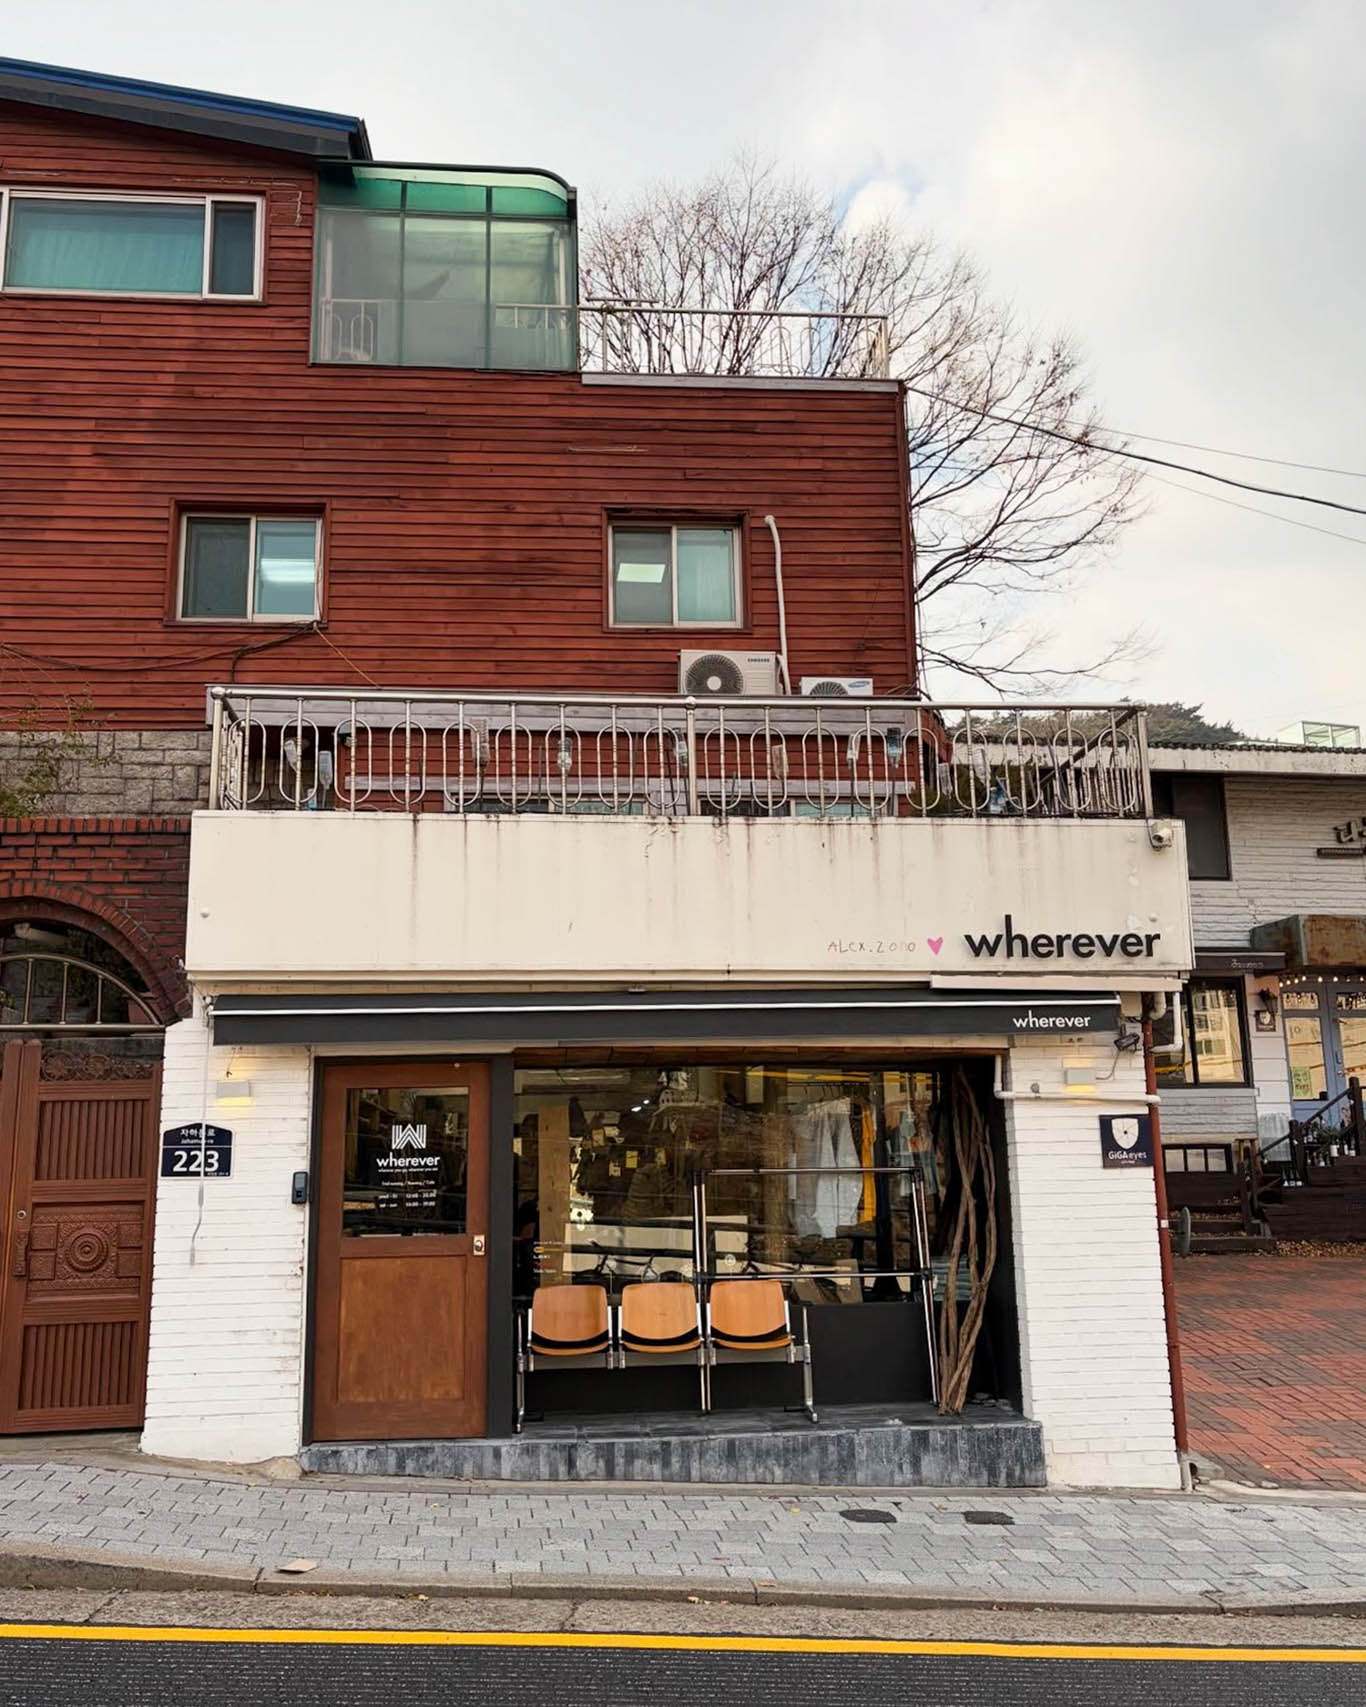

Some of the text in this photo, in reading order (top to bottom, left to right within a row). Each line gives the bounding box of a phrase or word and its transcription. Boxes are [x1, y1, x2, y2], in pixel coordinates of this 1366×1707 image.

[964, 914, 1161, 959] wherever
[1012, 1010, 1091, 1028] wherever
[173, 1150, 219, 1172] 223
[376, 1151, 441, 1167] wherever
